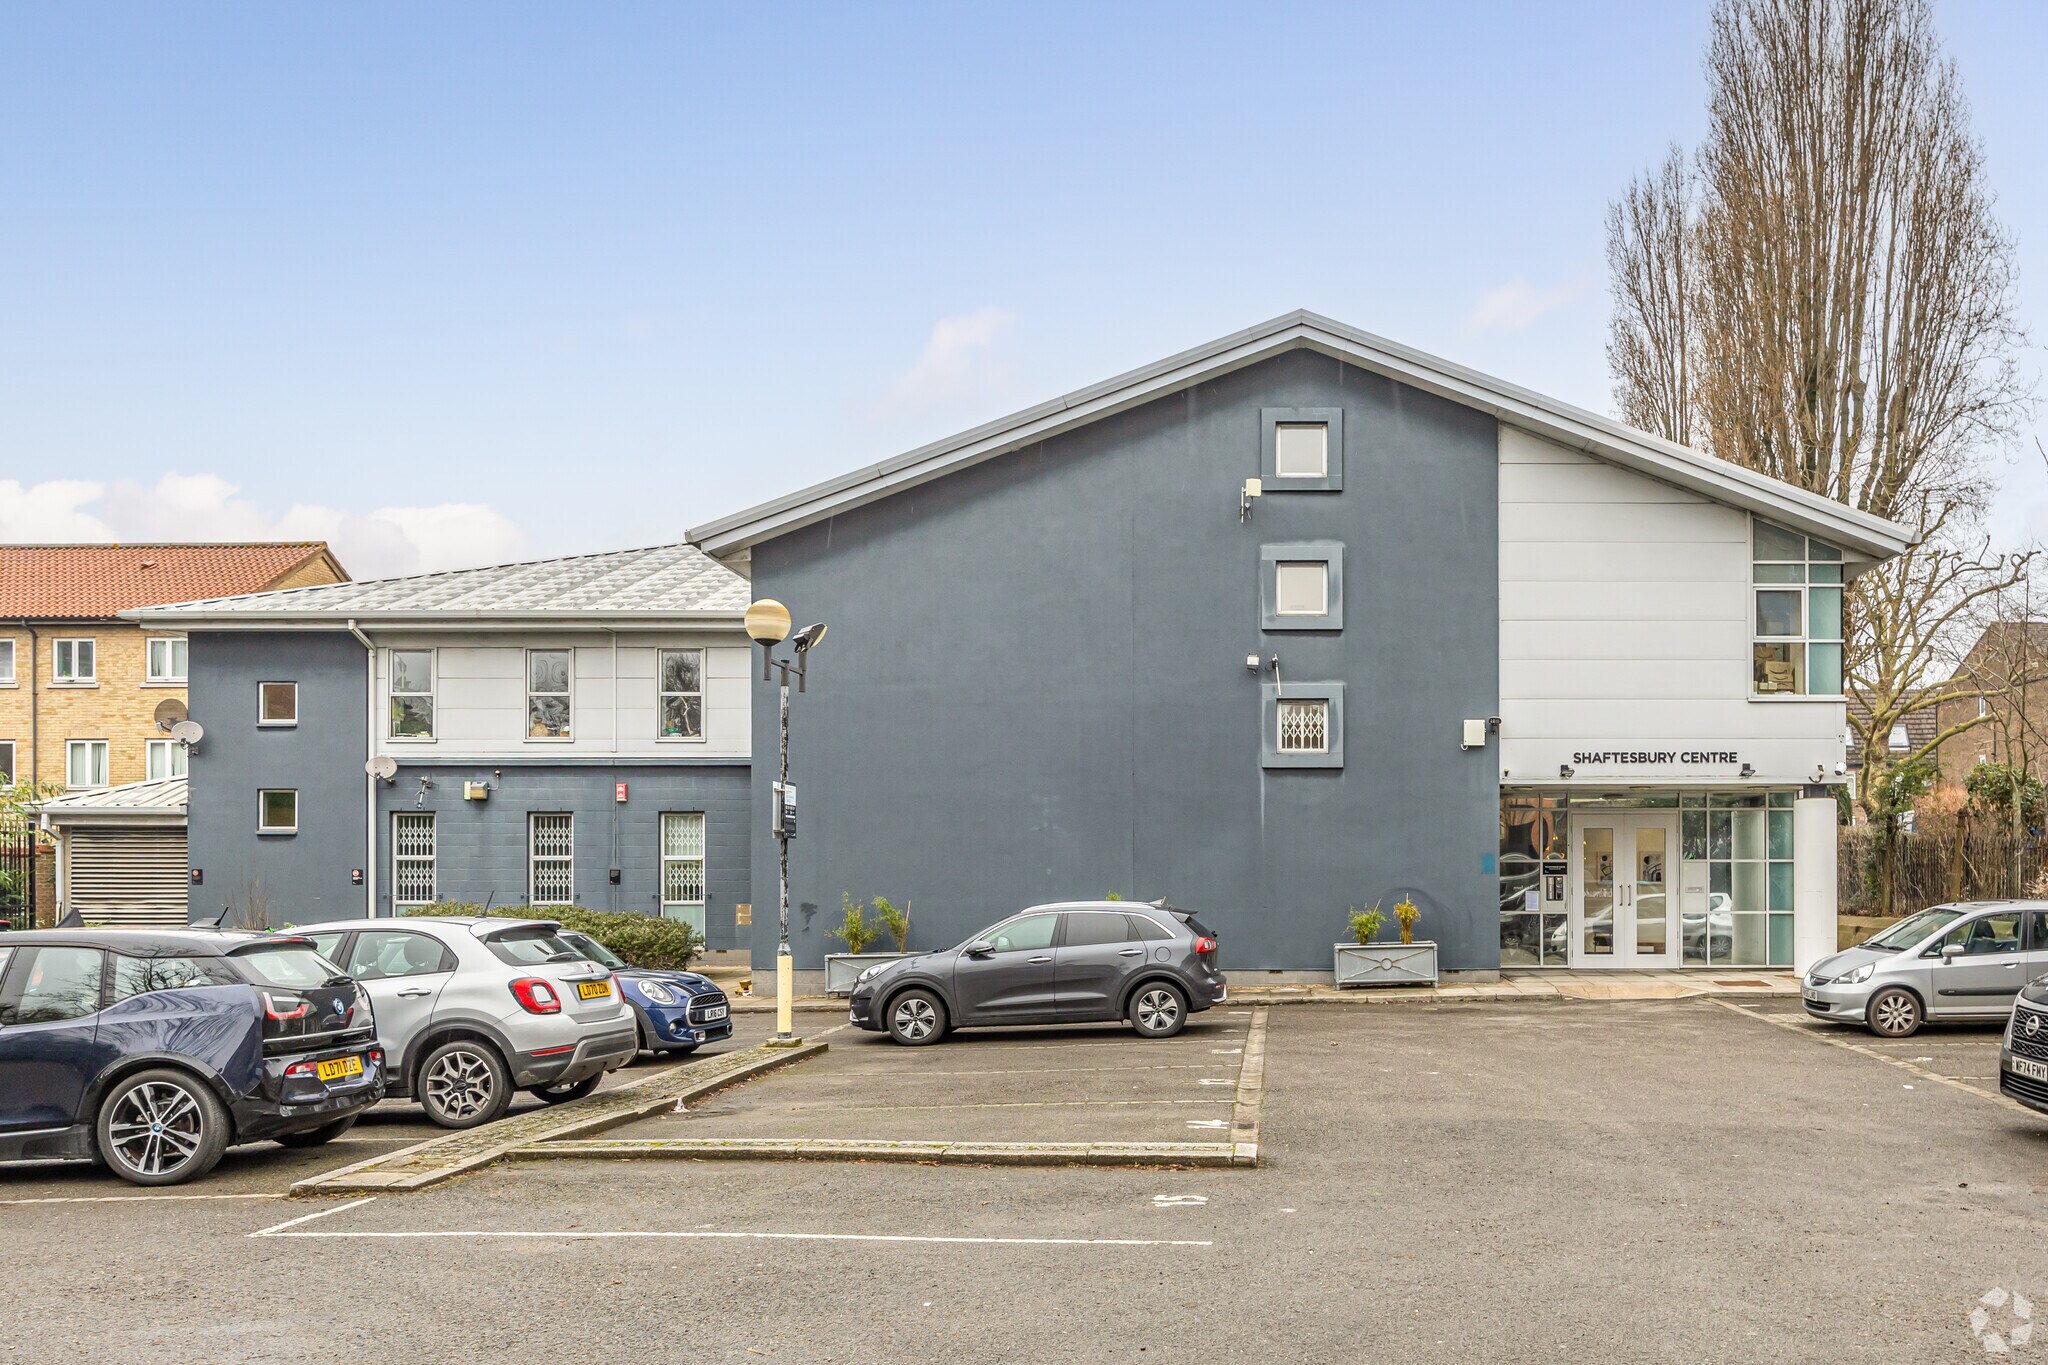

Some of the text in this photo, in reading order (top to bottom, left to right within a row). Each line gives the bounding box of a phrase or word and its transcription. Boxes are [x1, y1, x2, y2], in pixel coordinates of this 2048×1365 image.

[1573, 751, 1738, 764] SHAFTESBURY CENTRE
[322, 1061, 343, 1077] LD71
